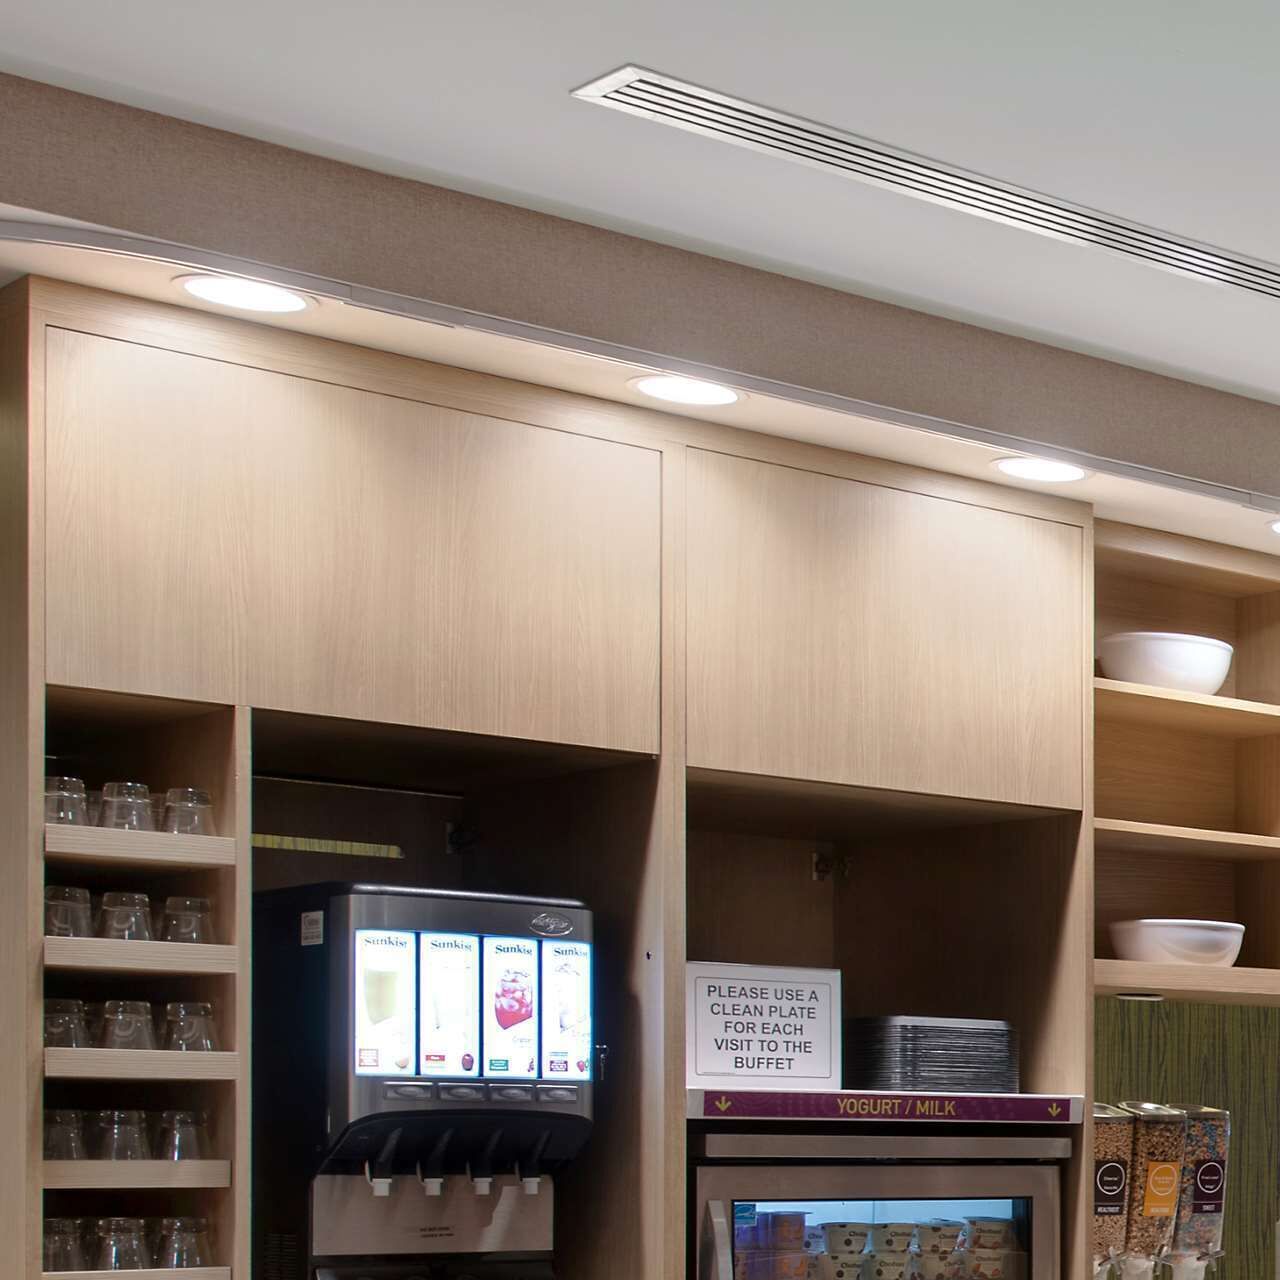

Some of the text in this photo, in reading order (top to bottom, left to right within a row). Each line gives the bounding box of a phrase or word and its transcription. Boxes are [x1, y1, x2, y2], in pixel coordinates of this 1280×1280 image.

[364, 936, 408, 949] Sunkist
[430, 939, 473, 952] Sunkist
[495, 944, 534, 956] Sunkist
[706, 984, 820, 1002] PLEASE USE A
[710, 1003, 817, 1019] CLEAN PLATE
[724, 1021, 804, 1036] FOR EACH
[714, 1038, 813, 1054] VISIT TO THE
[734, 1056, 795, 1070] BUFFET
[837, 1098, 902, 1115] YOGURT
[916, 1100, 957, 1116] MILK
